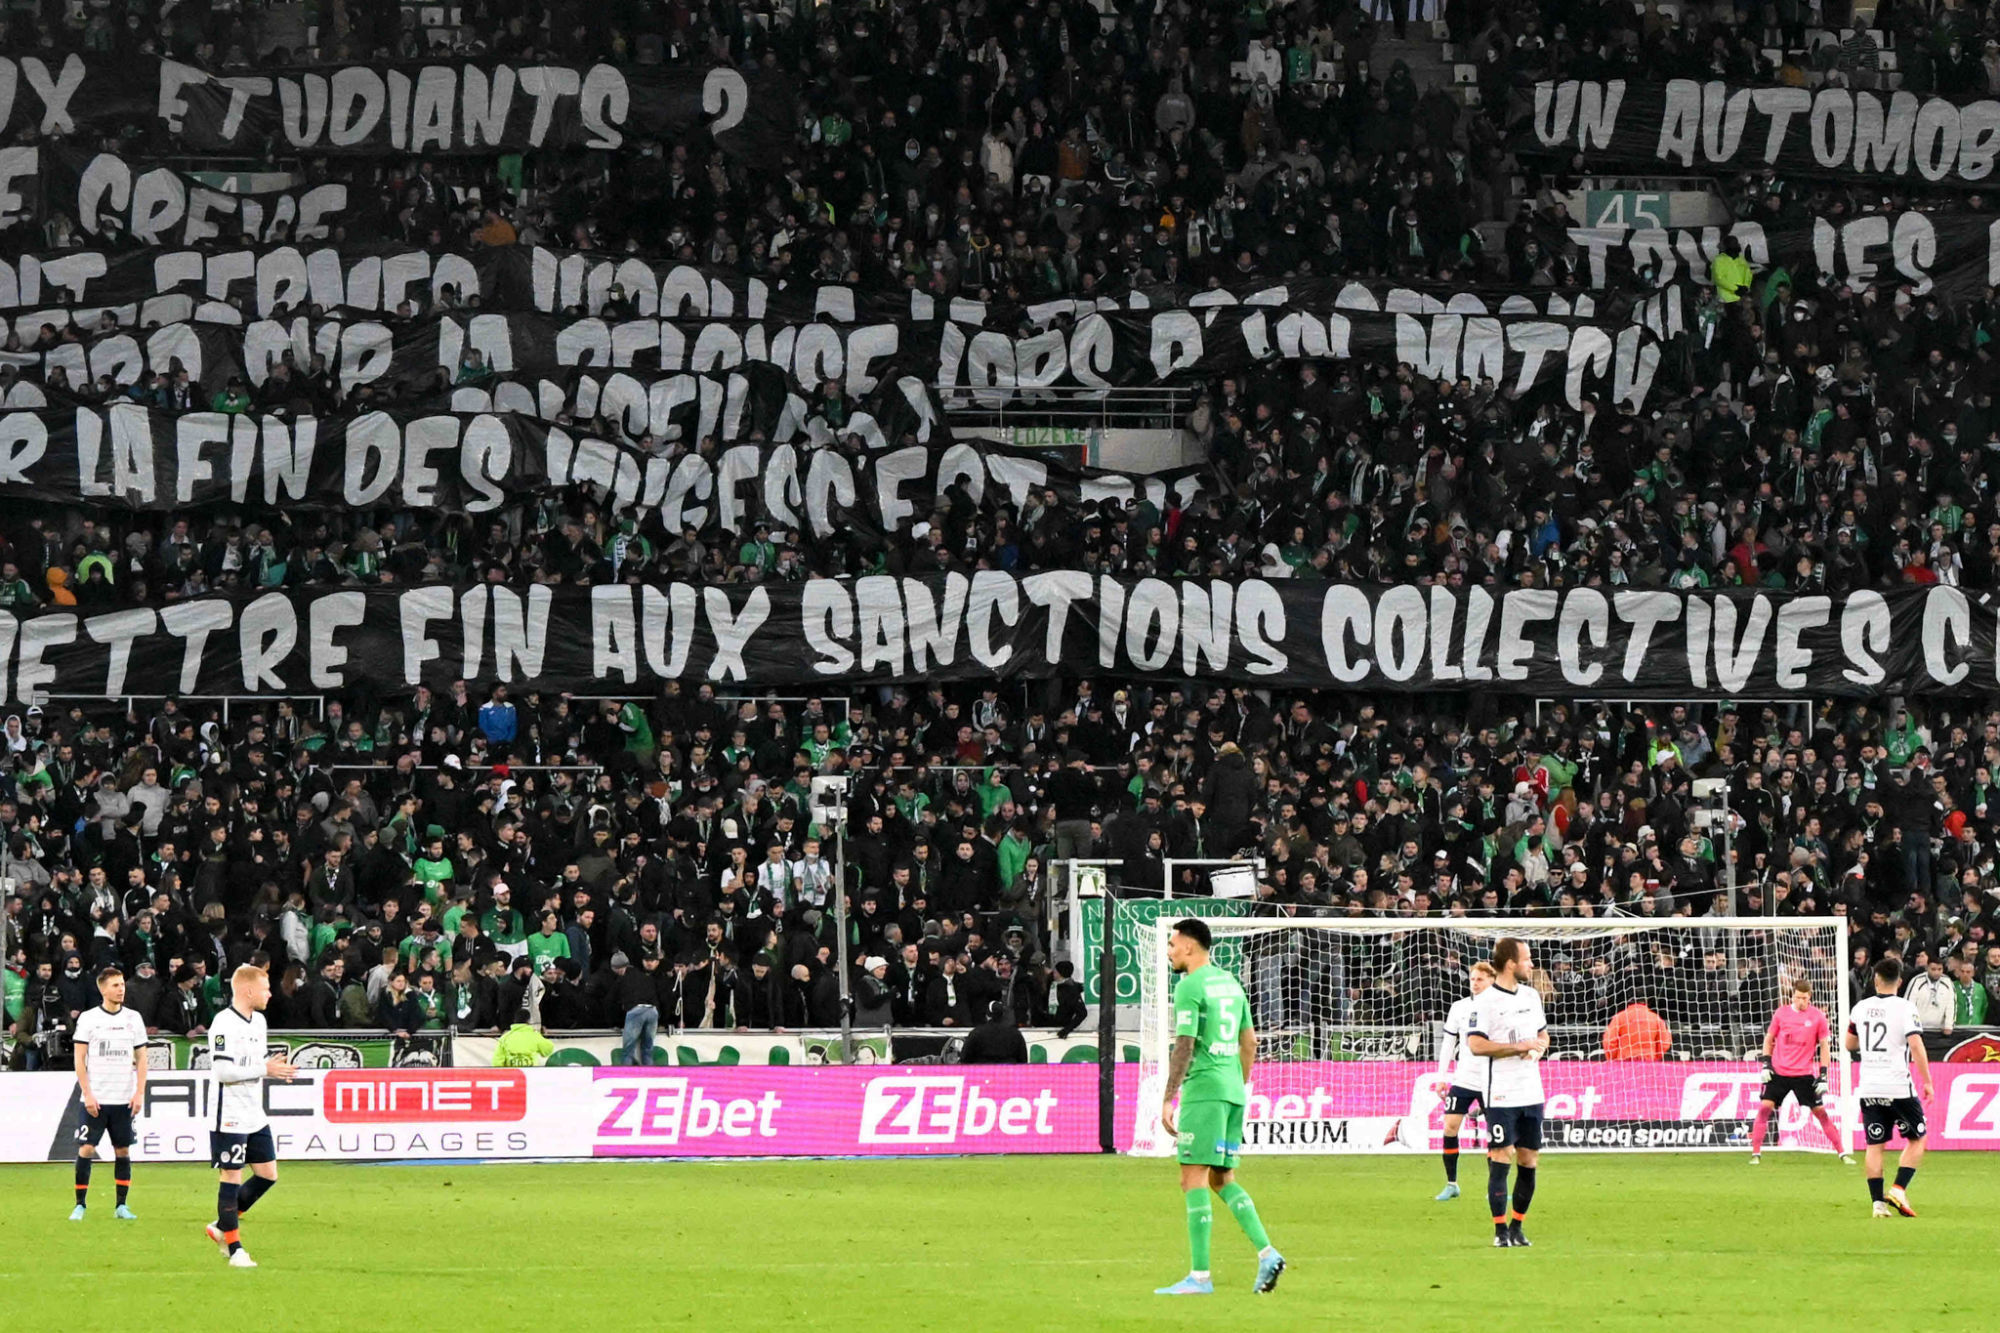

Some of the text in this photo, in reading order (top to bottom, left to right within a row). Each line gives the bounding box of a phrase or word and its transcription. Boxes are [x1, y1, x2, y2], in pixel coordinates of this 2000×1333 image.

[158, 57, 629, 152] ETUDIANTS
[1535, 78, 2000, 181] UN AUTOMOB
[1596, 194, 1661, 228] 45
[76, 404, 155, 503] LA
[177, 412, 318, 505] FIN
[344, 411, 511, 512] DES
[400, 583, 553, 684] FIN
[591, 582, 771, 685] AUX
[801, 569, 1290, 678] SANCTIONS
[1321, 583, 1891, 693] COLLECTIVES
[1921, 584, 2000, 688] C'
[1219, 998, 1237, 1041] 5
[1863, 1021, 1888, 1052] 12
[595, 1080, 782, 1140] ZEbet
[866, 1079, 1058, 1139] ZEbet
[143, 1130, 528, 1155] ÉCFAUDAGES
[1241, 1120, 1349, 1144] TRIUM
[1492, 1124, 1505, 1143] 9
[1563, 1123, 1713, 1147] le coq sportif
